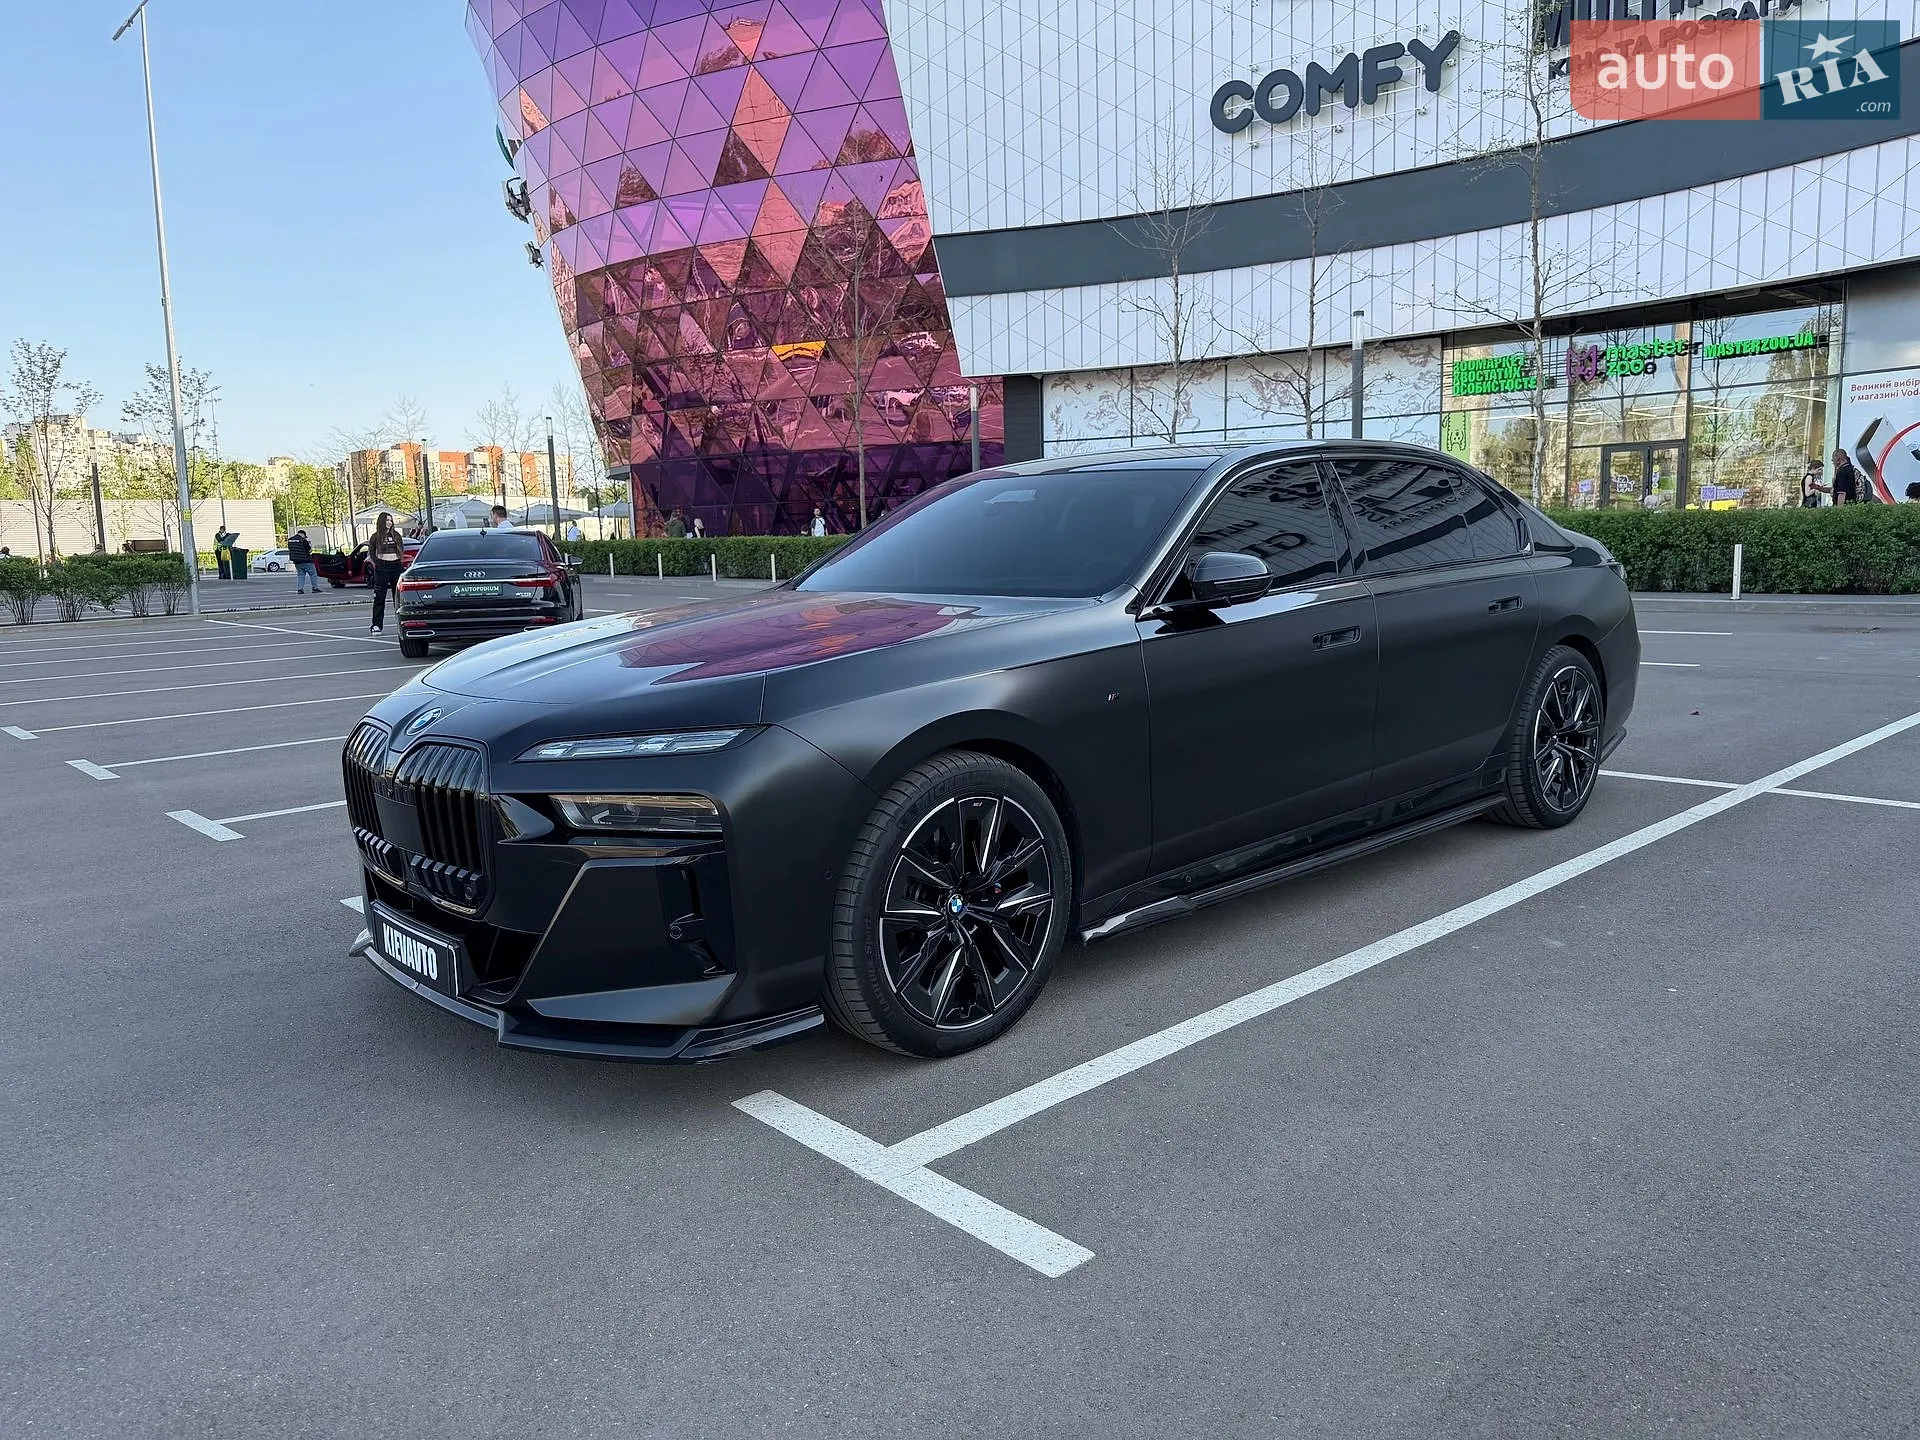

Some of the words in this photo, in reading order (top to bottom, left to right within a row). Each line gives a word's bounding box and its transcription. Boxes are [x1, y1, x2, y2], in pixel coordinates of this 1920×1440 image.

[1210, 30, 1460, 134] COMFY
[1605, 338, 1689, 361] master
[1703, 330, 1815, 358] MASTERZOO.UA
[1605, 359, 1645, 378] zoo
[1849, 395, 1856, 403] у
[1857, 389, 1899, 401] магазині
[1901, 388, 1920, 397] Vod
[1850, 380, 1892, 392] Великий
[1893, 378, 1920, 388] вибір
[460, 585, 499, 593] AUTOPODIUM
[382, 922, 438, 980] KIEVAVTO
